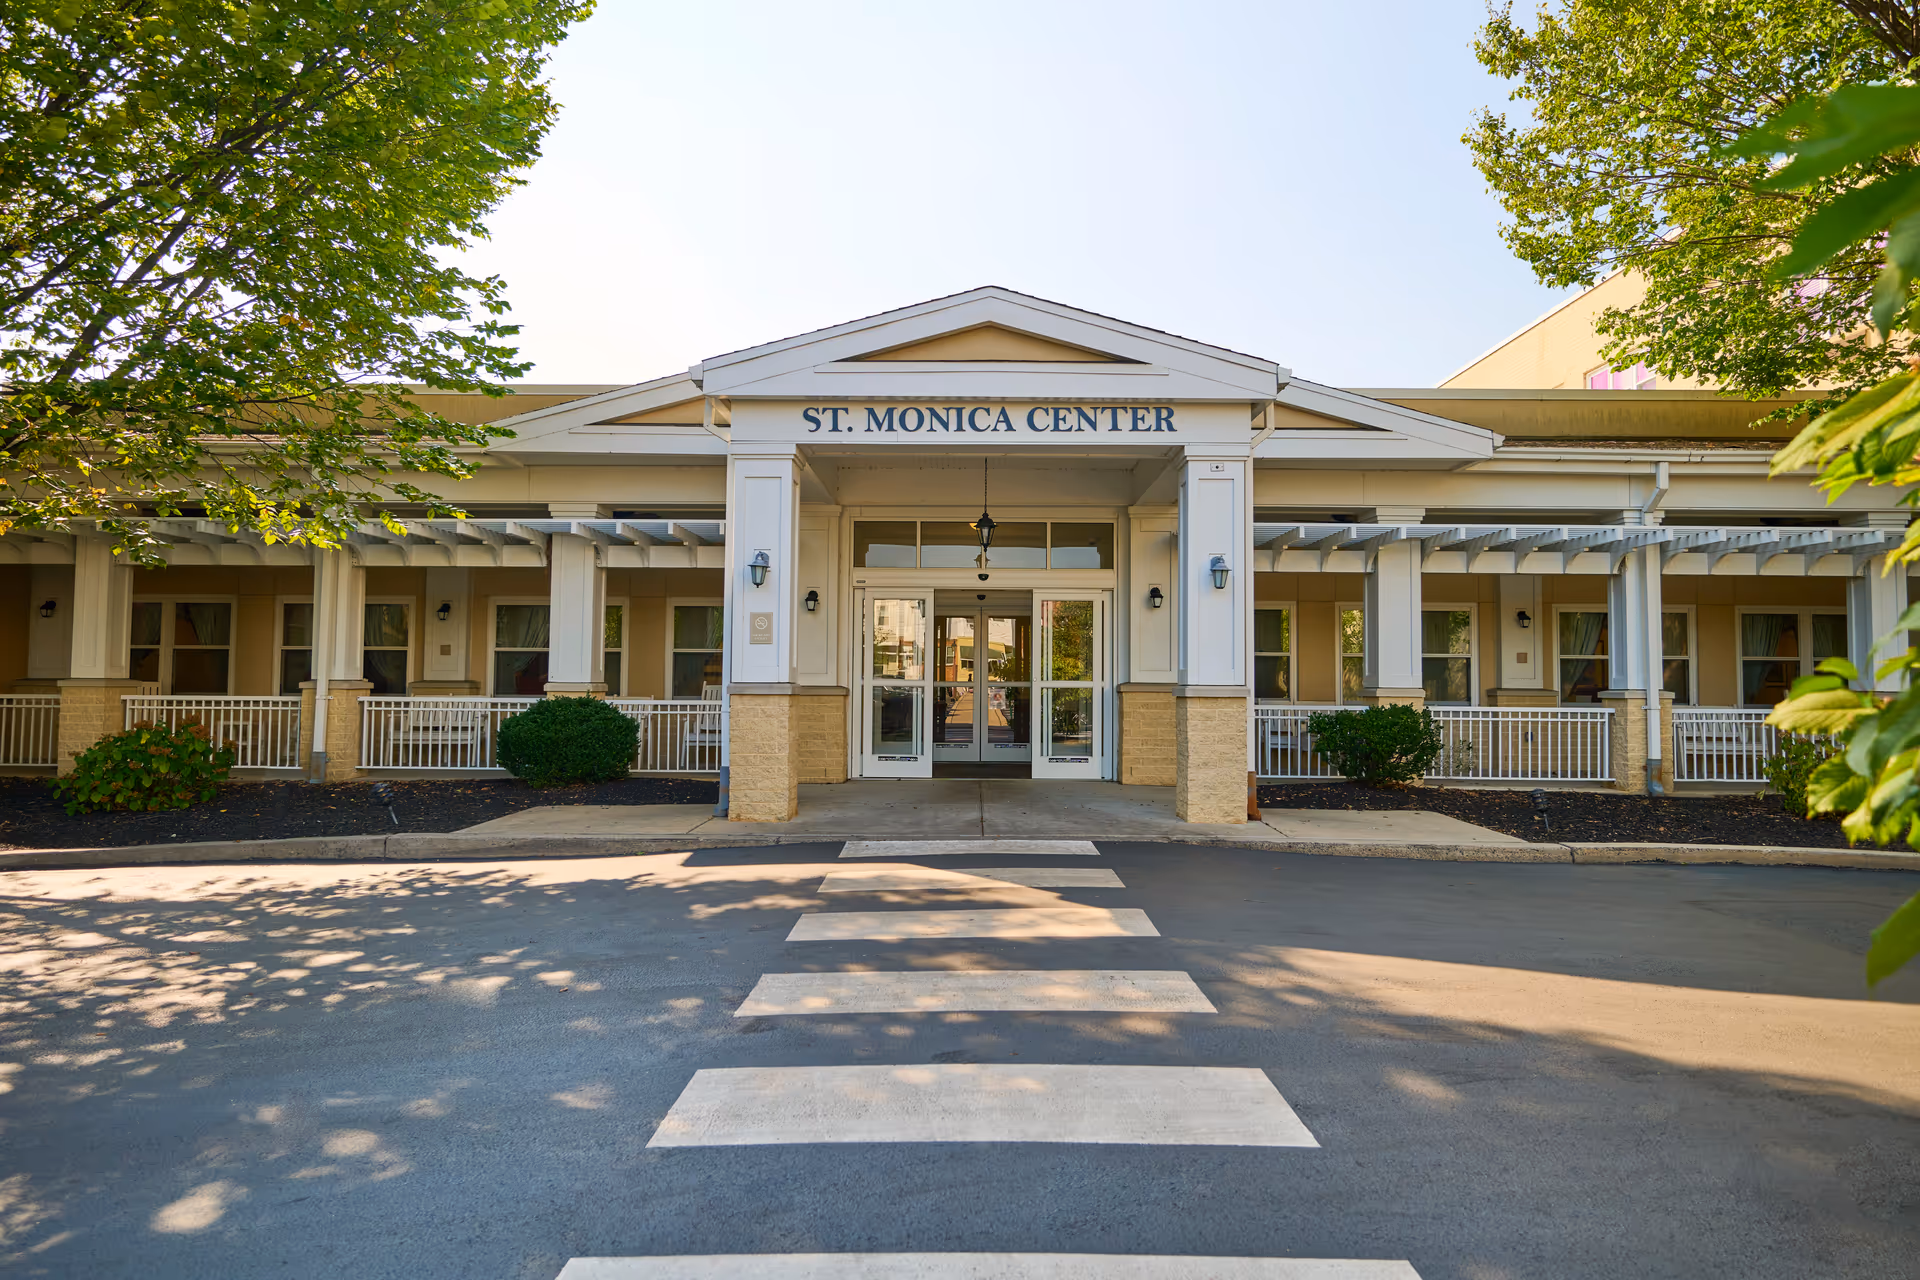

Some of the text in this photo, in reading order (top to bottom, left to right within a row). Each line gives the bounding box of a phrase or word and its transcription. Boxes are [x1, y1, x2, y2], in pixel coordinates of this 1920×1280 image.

[803, 406, 1177, 433] ST. MONICA CENTER
